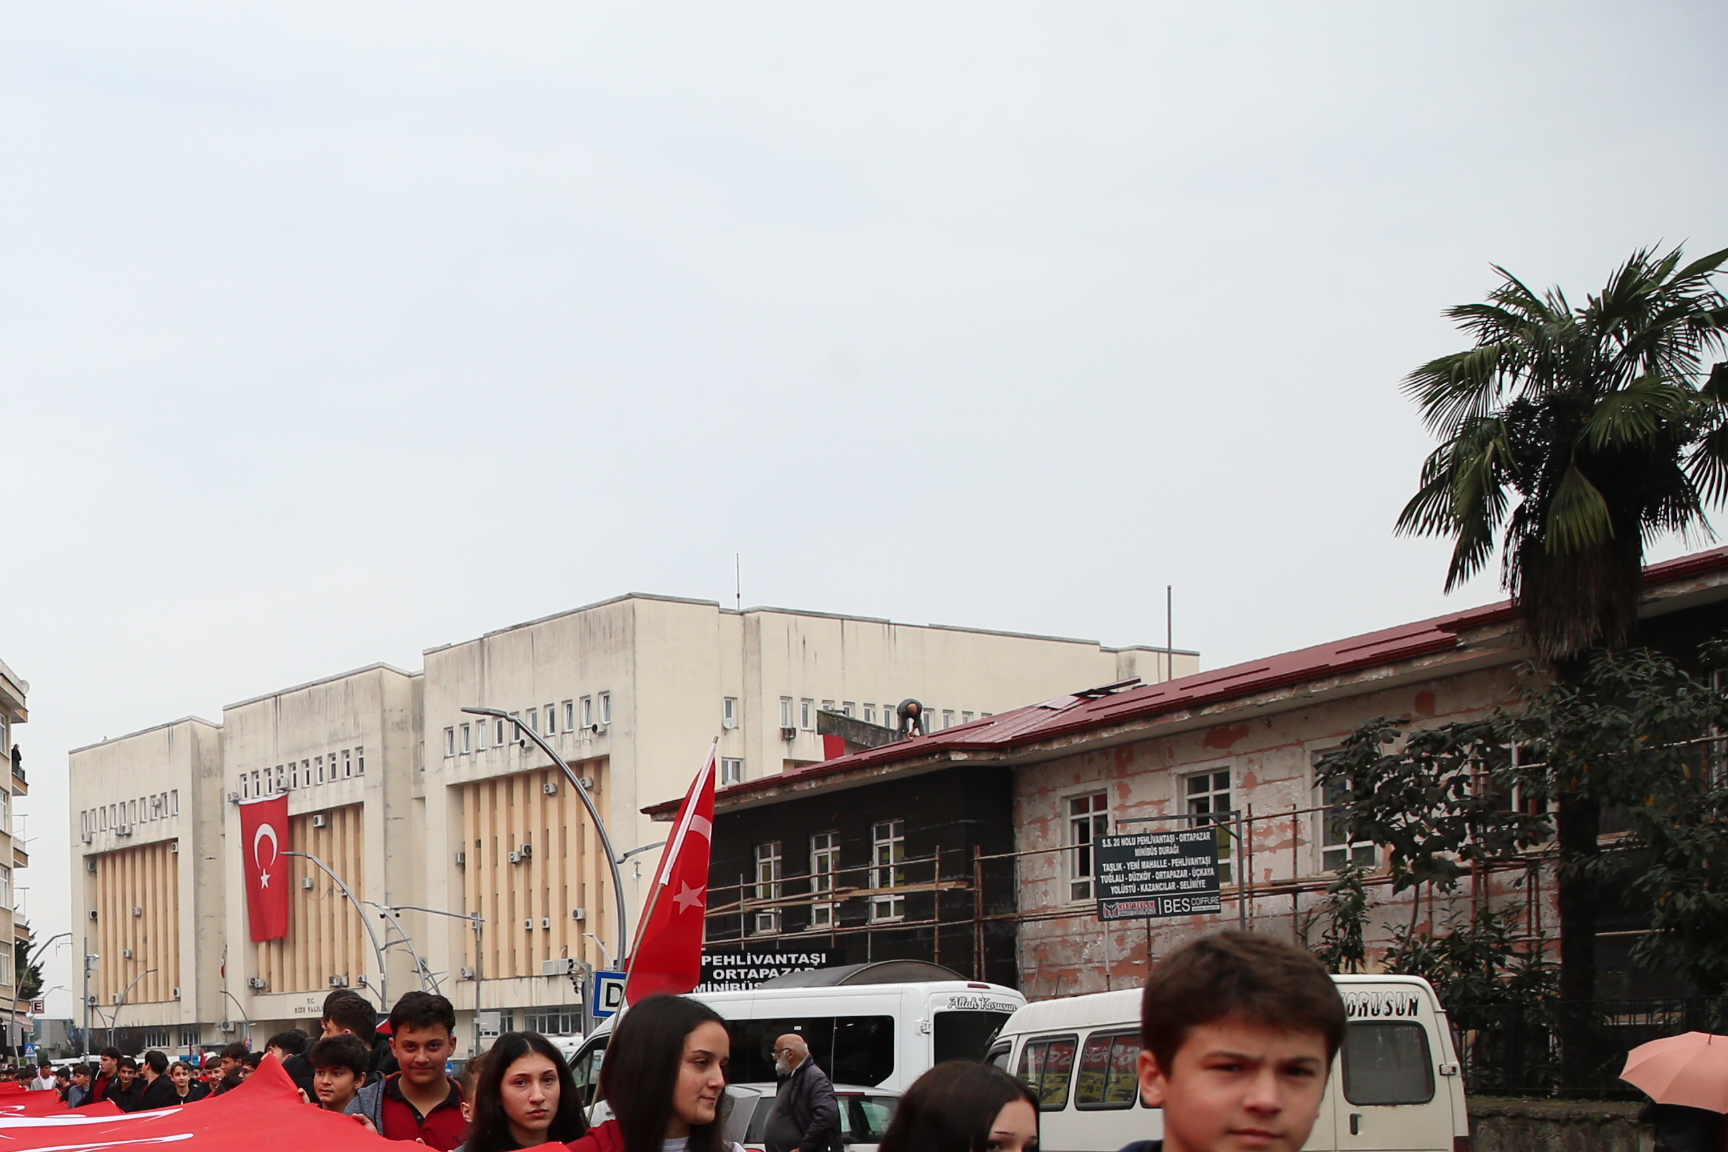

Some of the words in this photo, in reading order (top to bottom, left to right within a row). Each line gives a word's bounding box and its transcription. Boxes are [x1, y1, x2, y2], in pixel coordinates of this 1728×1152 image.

[1179, 831, 1211, 842] ORTAPAZAR
[1141, 859, 1168, 870] MAHALLE
[1164, 898, 1191, 914] BES
[701, 952, 827, 967] PEHLİVANTAŞI
[605, 982, 624, 1007] D
[947, 995, 980, 1011] Allah
[978, 996, 1018, 1013] Korusun
